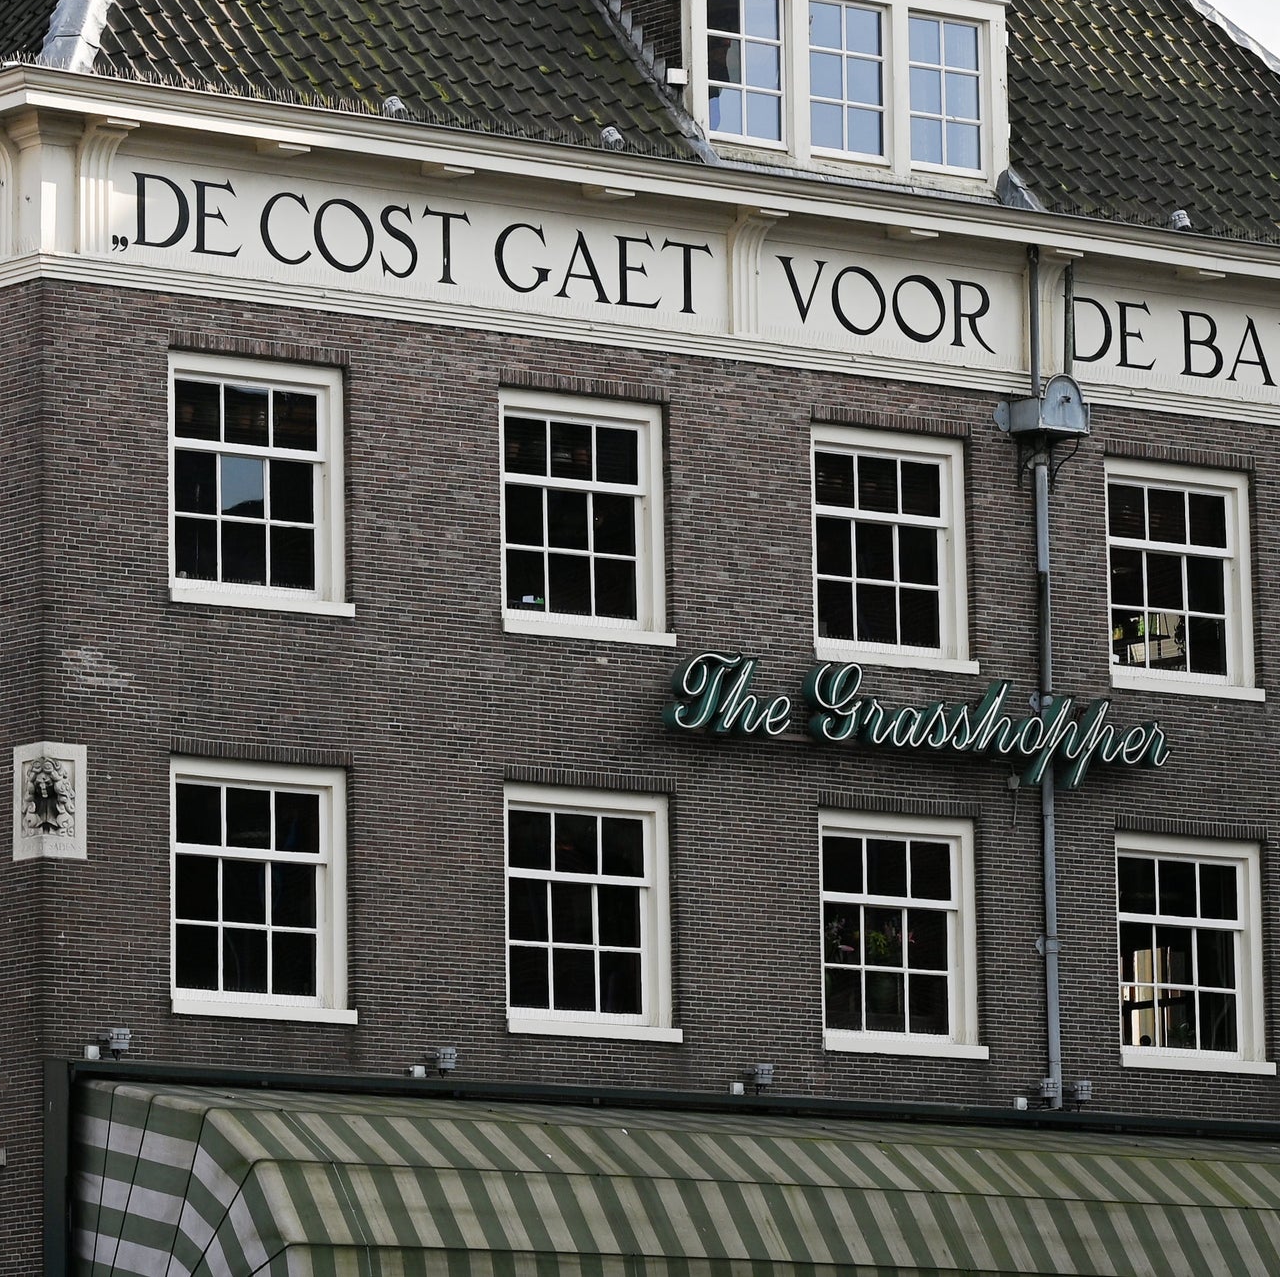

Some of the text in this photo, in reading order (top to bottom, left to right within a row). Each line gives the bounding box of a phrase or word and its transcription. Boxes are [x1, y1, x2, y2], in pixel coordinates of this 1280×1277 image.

[259, 192, 472, 286] COST
[494, 222, 714, 315] GAET
[774, 254, 997, 355] VOOR
[1067, 296, 1157, 372] DE
[666, 650, 1171, 789] The Grasshopper
